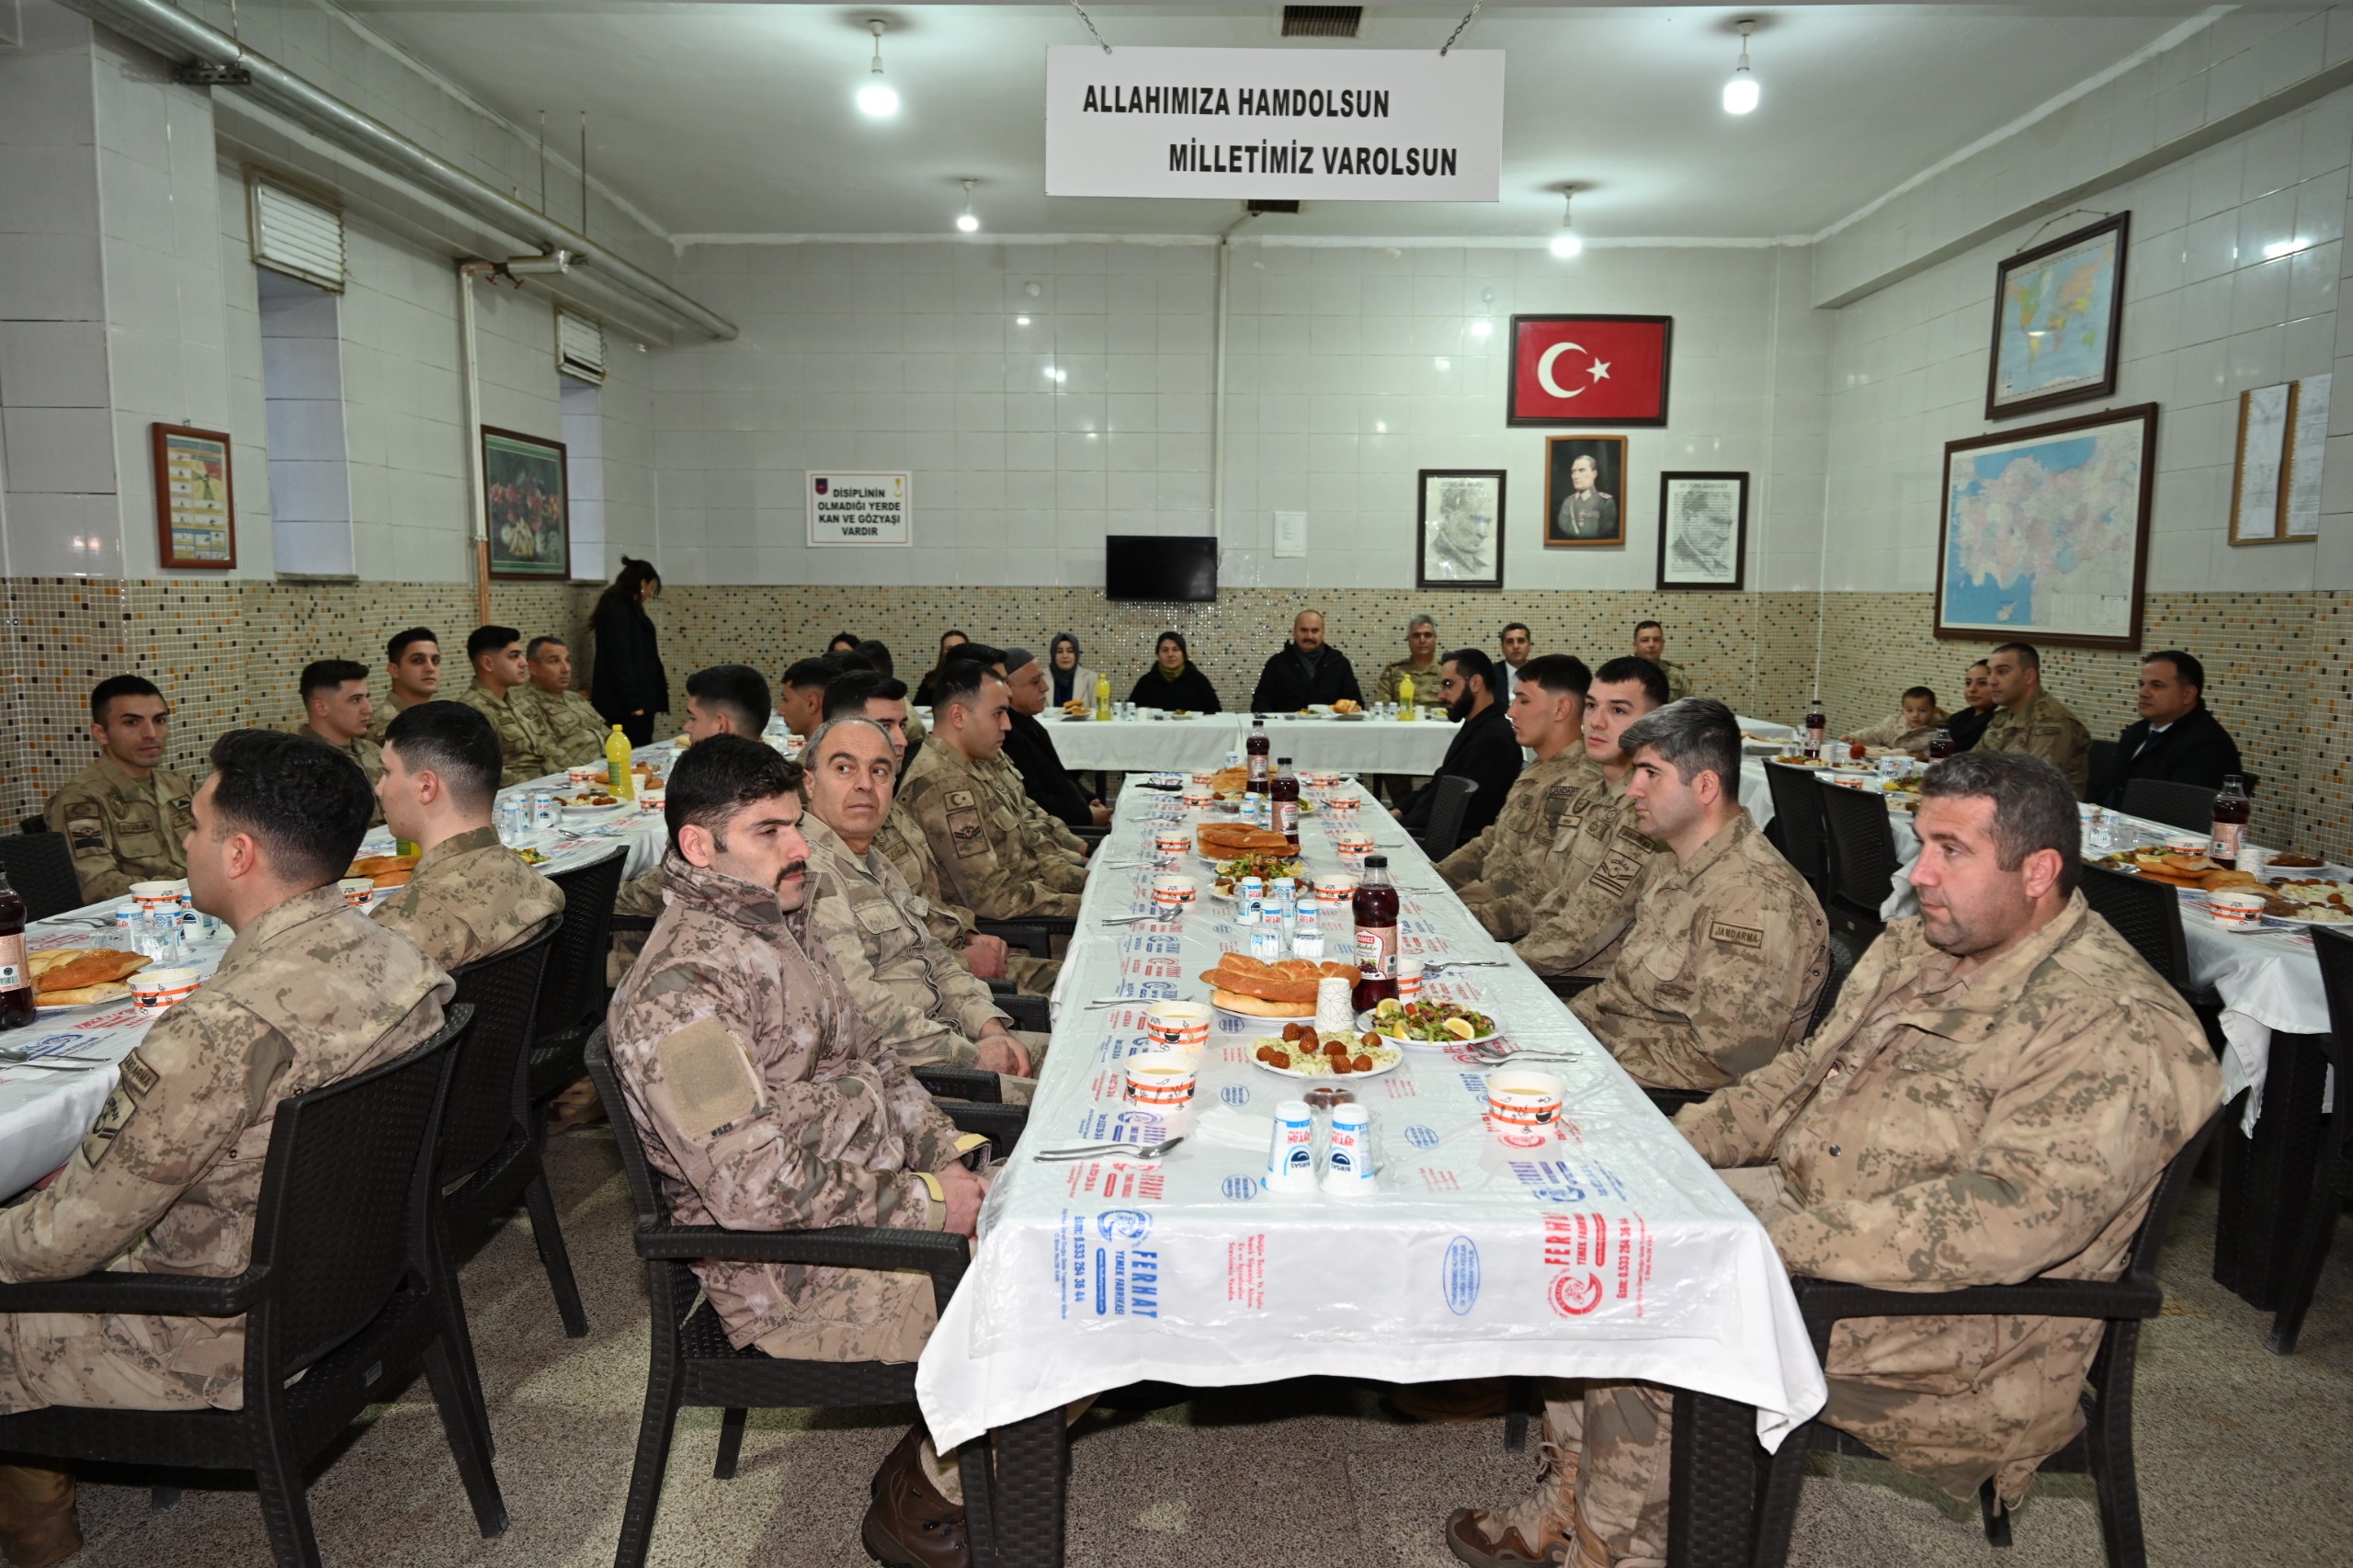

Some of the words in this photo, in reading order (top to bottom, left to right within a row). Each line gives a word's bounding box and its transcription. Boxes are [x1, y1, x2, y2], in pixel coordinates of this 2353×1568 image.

[1082, 85, 1230, 115] ALLAHIMIZA
[1238, 88, 1390, 118] HAMDOLSUN
[1169, 138, 1313, 175] MİLLETİMİZ
[1323, 147, 1458, 176] VAROLSUN
[833, 487, 885, 497] DİSİPLİNİN
[818, 500, 865, 511] OLMADIĞI
[869, 502, 901, 511] YERDE
[818, 514, 839, 523] KAN
[843, 514, 855, 523] VE
[858, 512, 901, 525] GÖZYAŞI
[842, 527, 878, 536] VARDIR
[1715, 926, 1758, 944] JANDARMA
[1115, 1250, 1124, 1277] YEMEK
[1131, 1250, 1157, 1318] FERHAT
[1616, 1279, 1628, 1299] Gsm:
[1115, 1278, 1125, 1314] FABRİKASI
